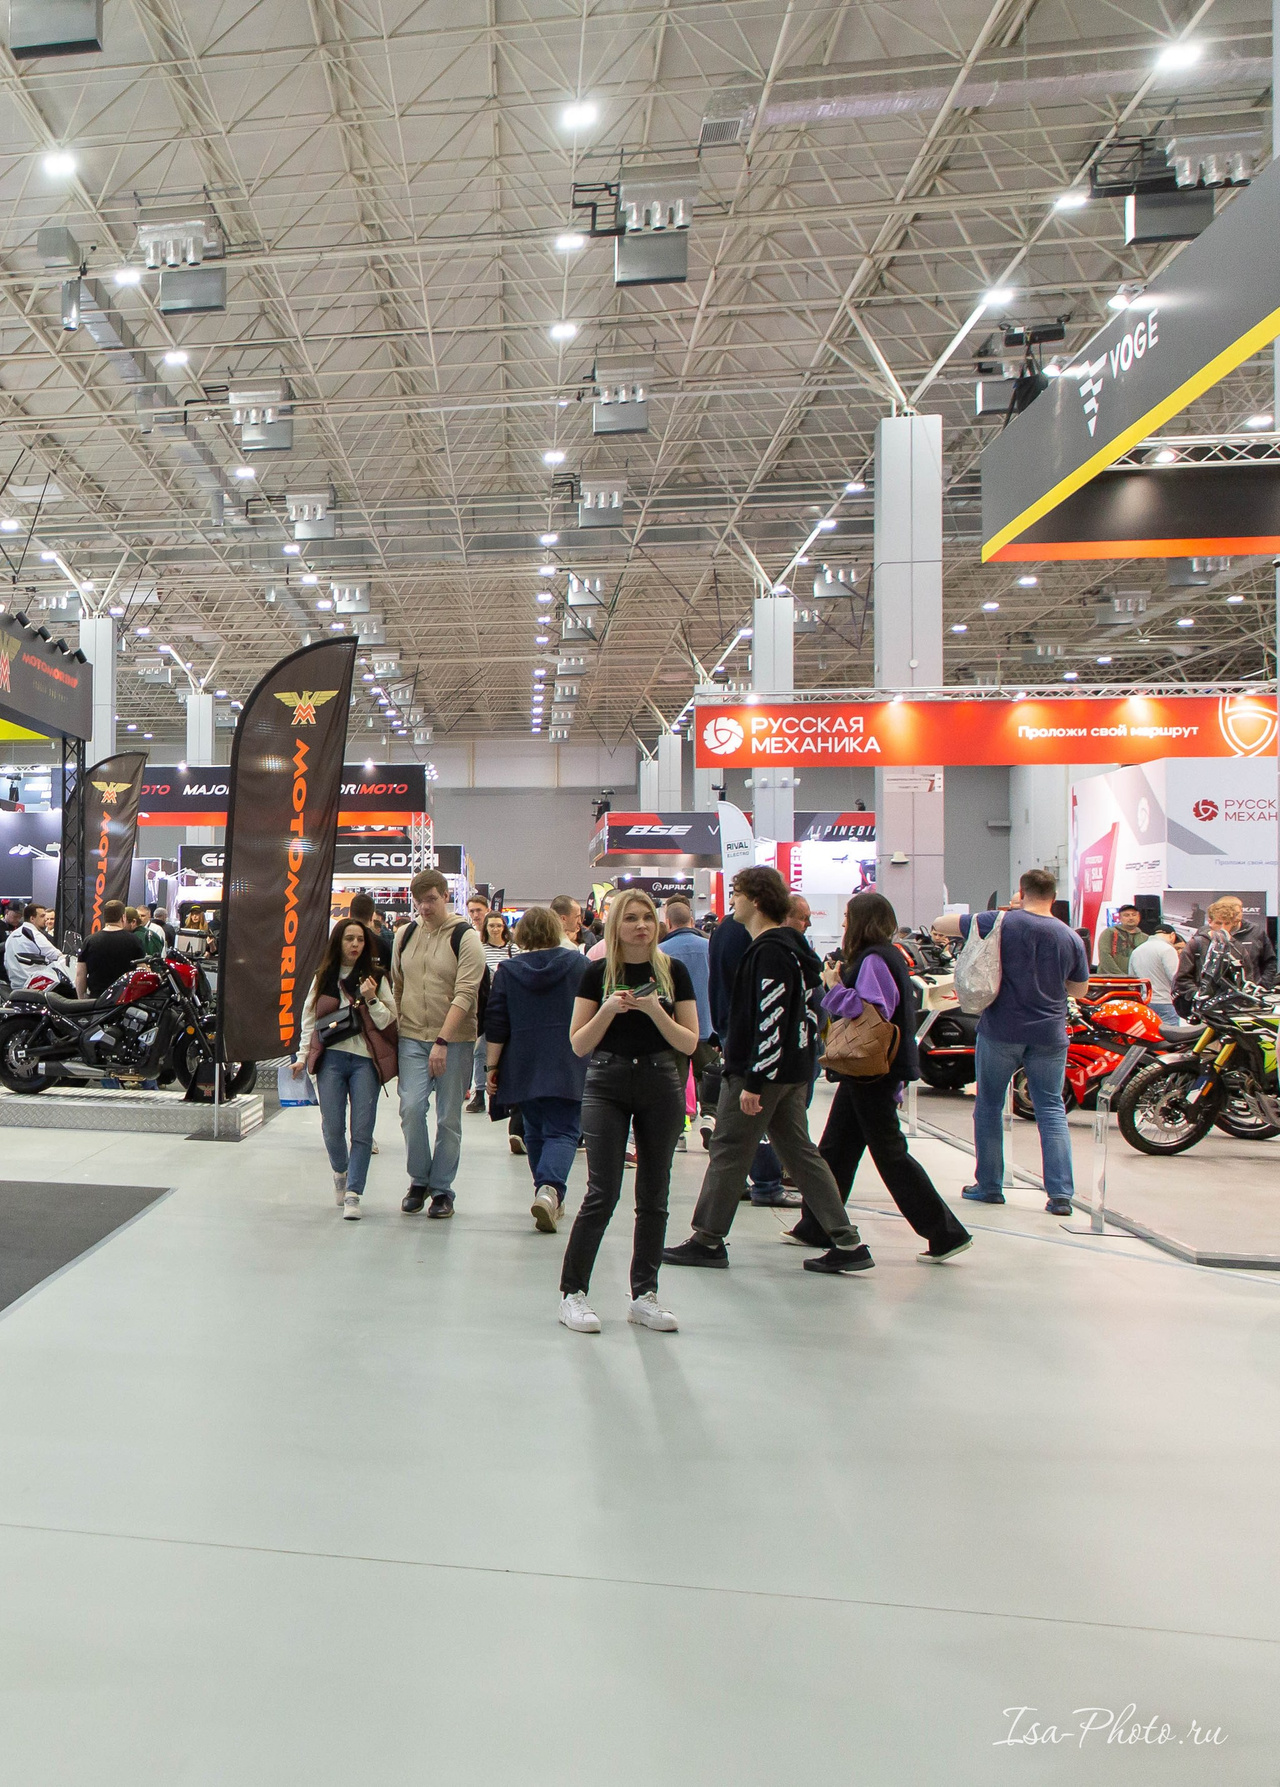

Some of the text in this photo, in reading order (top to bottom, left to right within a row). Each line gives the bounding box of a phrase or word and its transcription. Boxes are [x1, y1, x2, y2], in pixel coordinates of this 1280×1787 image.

[1109, 307, 1160, 379] VOGE
[750, 716, 865, 733] РУССКАЯ
[1018, 724, 1200, 740] Проложи свой маршрут
[750, 735, 882, 754] МЕХАНИКА
[182, 784, 230, 796] MAJO
[625, 825, 693, 836] BSE
[726, 842, 749, 851] RIVAL
[278, 738, 311, 1042] MOTOMORINI
